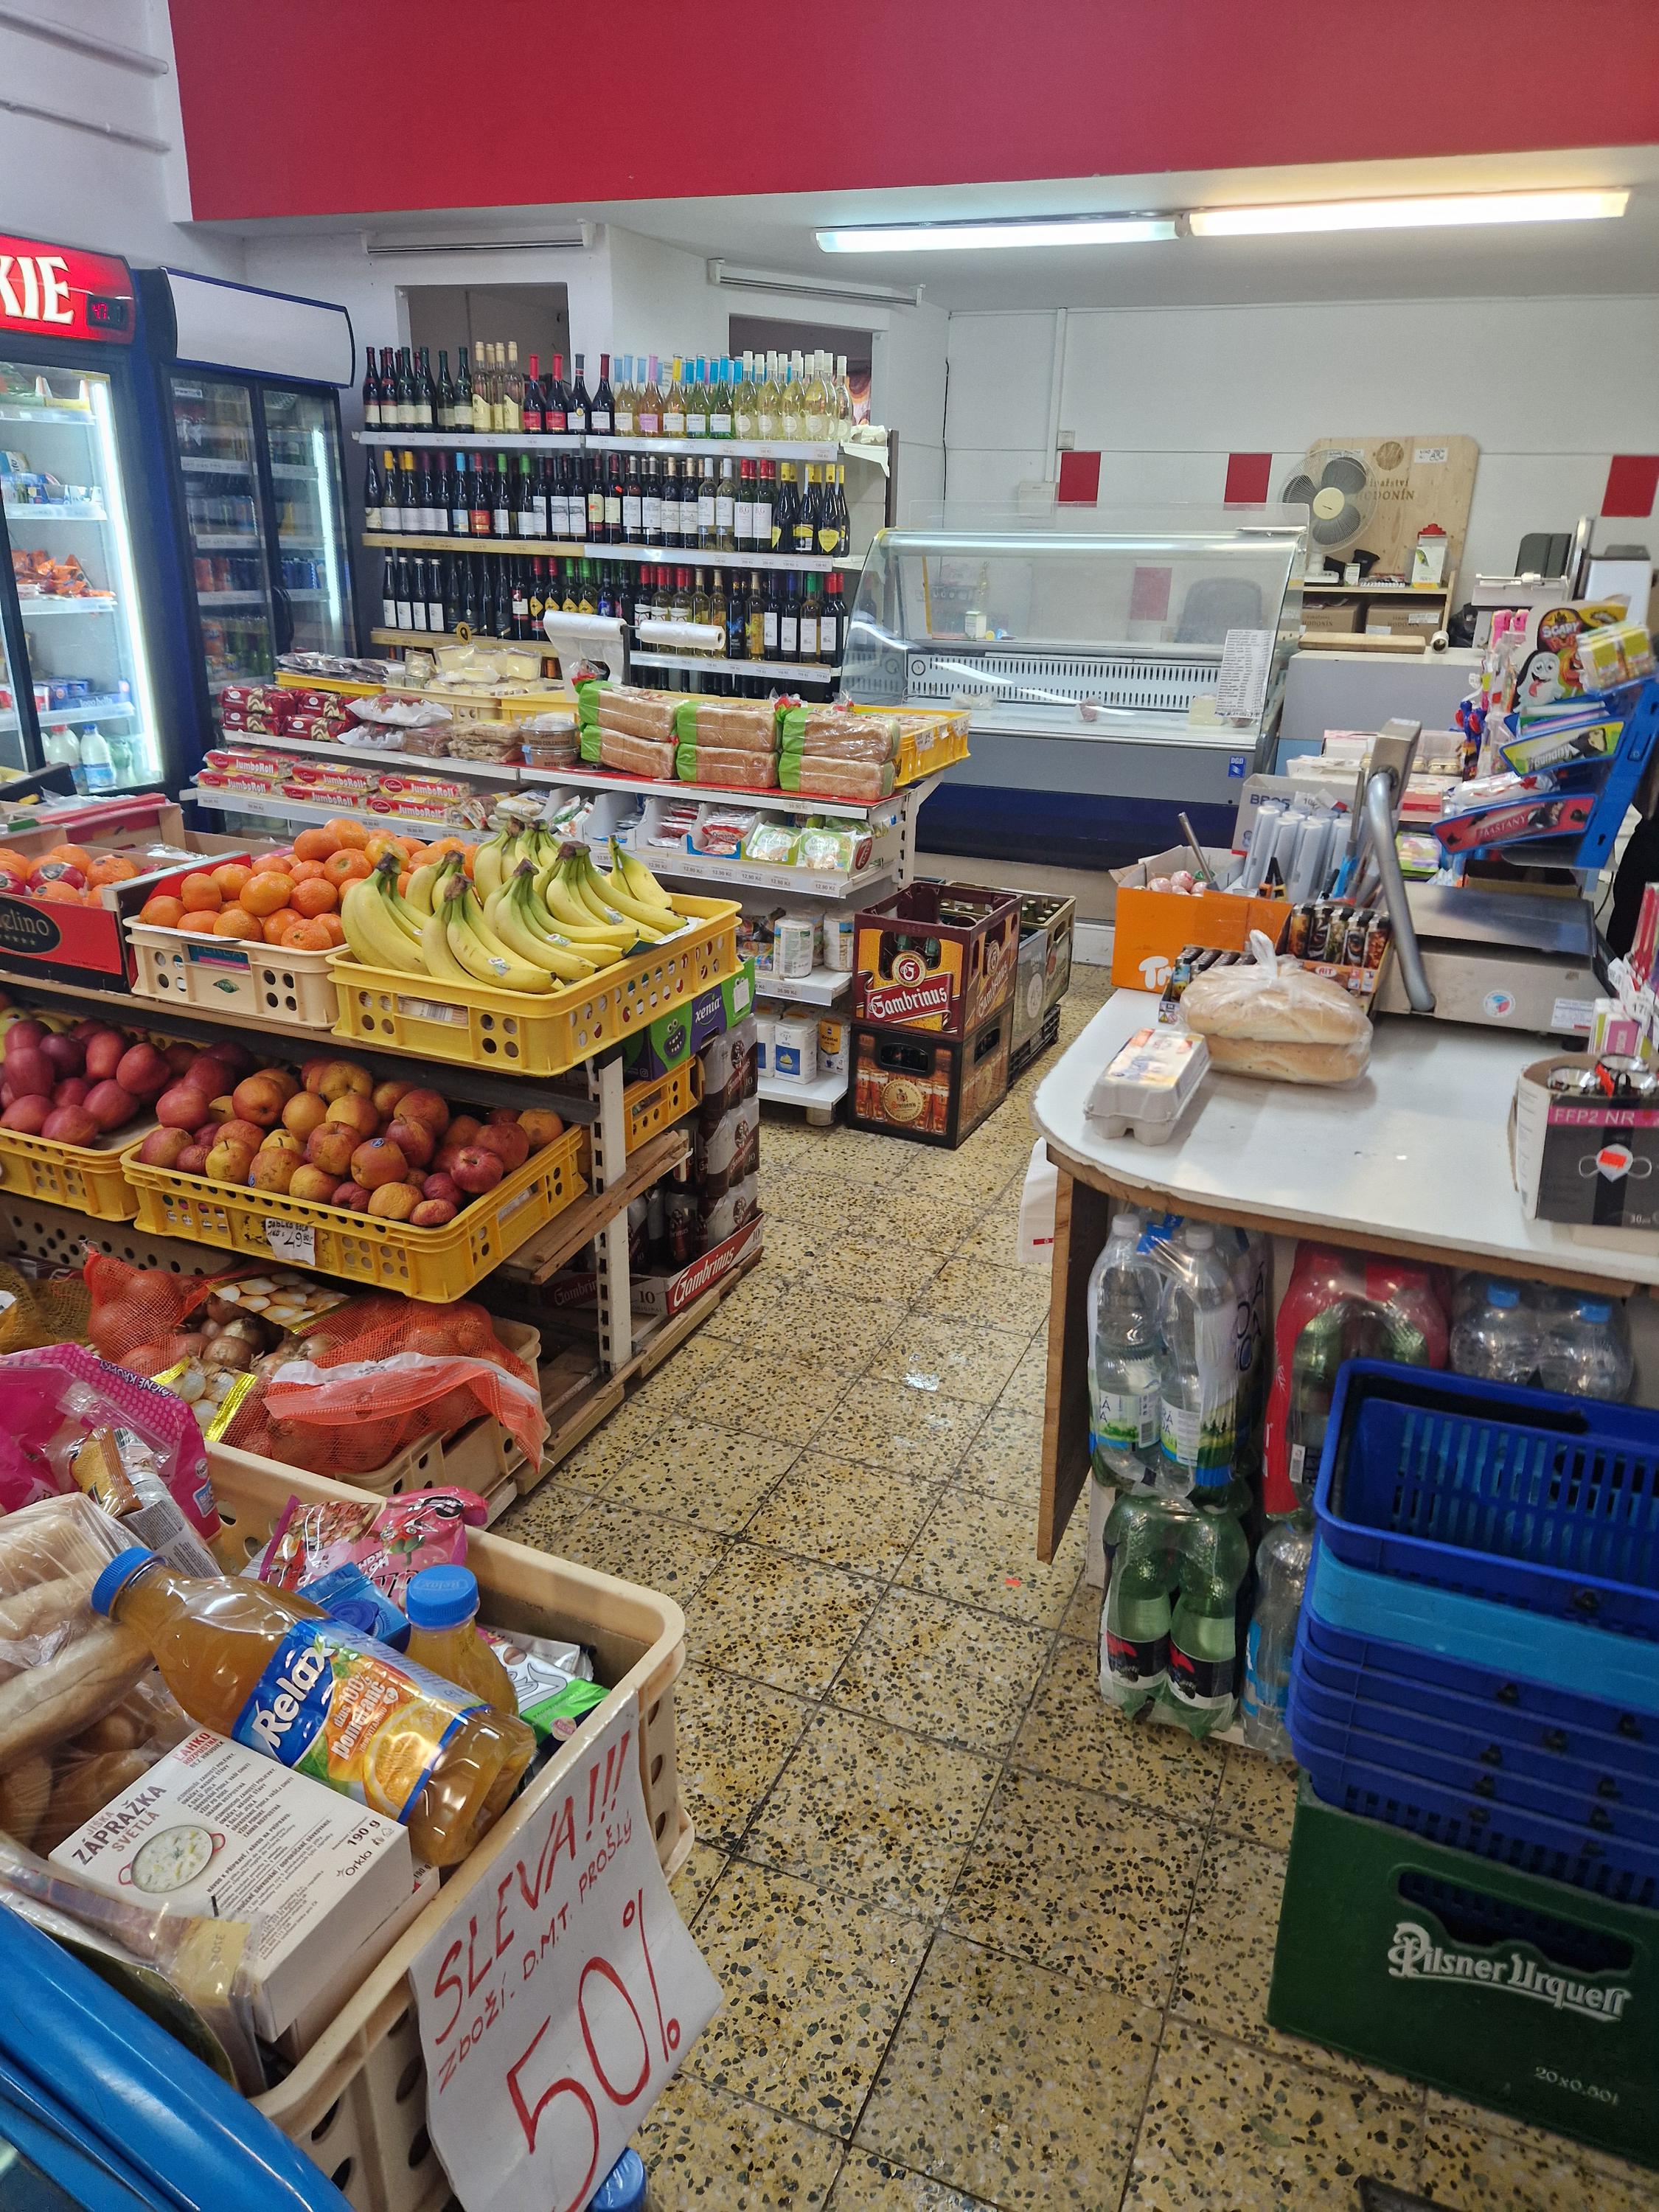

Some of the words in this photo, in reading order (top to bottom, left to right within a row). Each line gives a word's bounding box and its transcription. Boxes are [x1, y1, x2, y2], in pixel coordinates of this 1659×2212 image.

[235, 759, 274, 774] JumboRoll
[227, 779, 266, 794] JumboRoll
[322, 773, 366, 790] JumboRoll
[411, 782, 454, 798] JumboRoll
[312, 792, 353, 807] JumboRoll
[398, 804, 441, 819] JumboRoll
[694, 997, 721, 1023] xenia
[867, 987, 948, 1019] Gambrinus
[1554, 1108, 1599, 1124] FFP2
[1605, 1110, 1635, 1126] NR
[673, 1245, 735, 1308] Gambrinus
[554, 1279, 598, 1307] Gambrin
[639, 1290, 655, 1304] 10
[251, 1646, 336, 1749] Relax
[337, 1668, 371, 1707] 100%
[71, 1785, 168, 1866] ZÁPRAŽKA
[86, 1809, 116, 1837] JÍŠKA
[111, 1809, 160, 1853] SVĚTLÁ
[347, 1827, 369, 1846] 190
[369, 1819, 380, 1829] g
[345, 1849, 373, 1877] Orkla
[578, 1809, 633, 1905] PROŠLÝ
[414, 1867, 425, 1879] 190
[434, 1730, 632, 2046] SLEVA!!!
[1388, 1921, 1508, 1982] Pilsner
[507, 1887, 683, 2212] 50%
